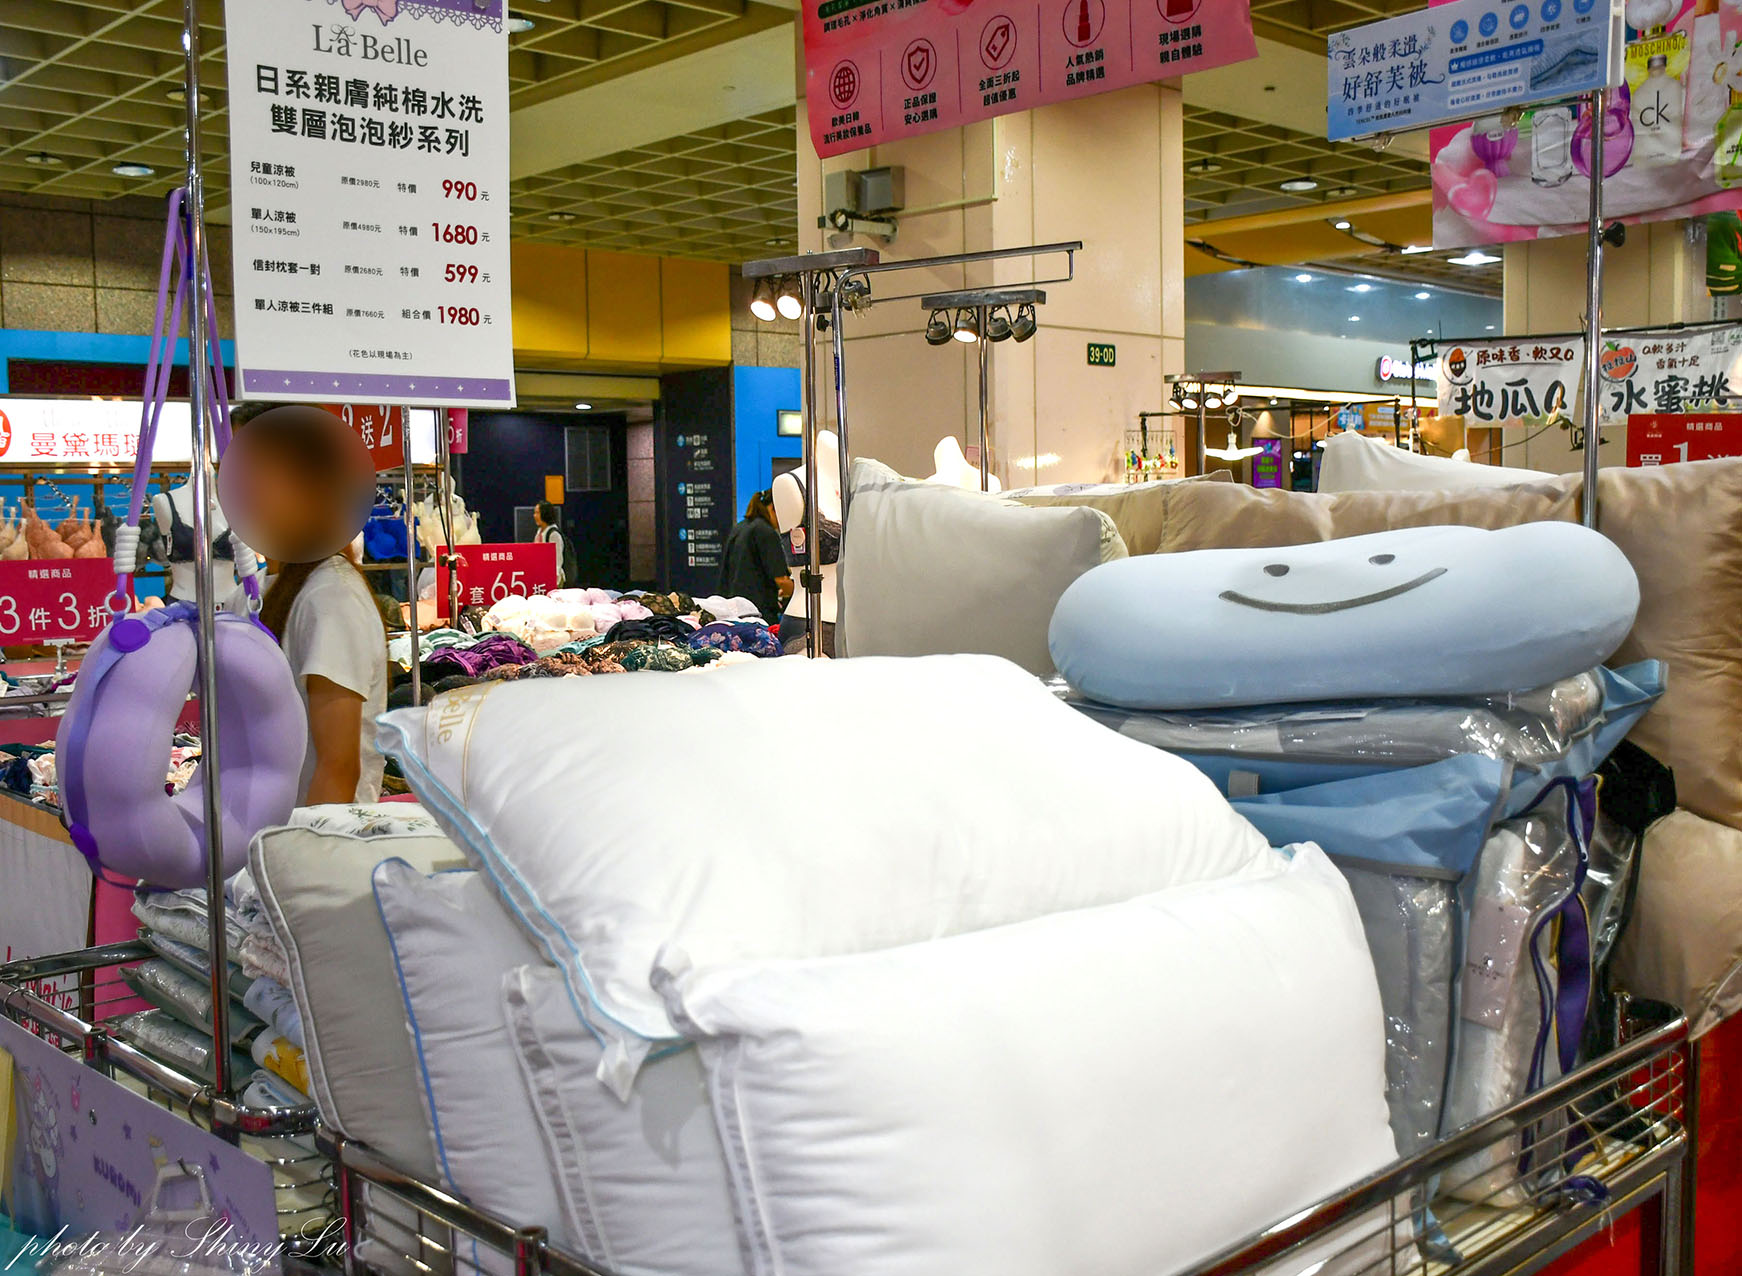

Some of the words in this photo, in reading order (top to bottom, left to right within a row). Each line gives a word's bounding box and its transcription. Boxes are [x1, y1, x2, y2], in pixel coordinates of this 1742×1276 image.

[361, 34, 428, 67] Belle
[256, 64, 484, 123] 日系親膚純棉水洗
[270, 103, 469, 157] 雙層泡泡紗系列
[250, 161, 296, 177] 兒童涼被
[251, 208, 296, 223] 單人涼被
[254, 299, 334, 315] 單人涼被三件組
[1611, 371, 1730, 414] 水蜜桃
